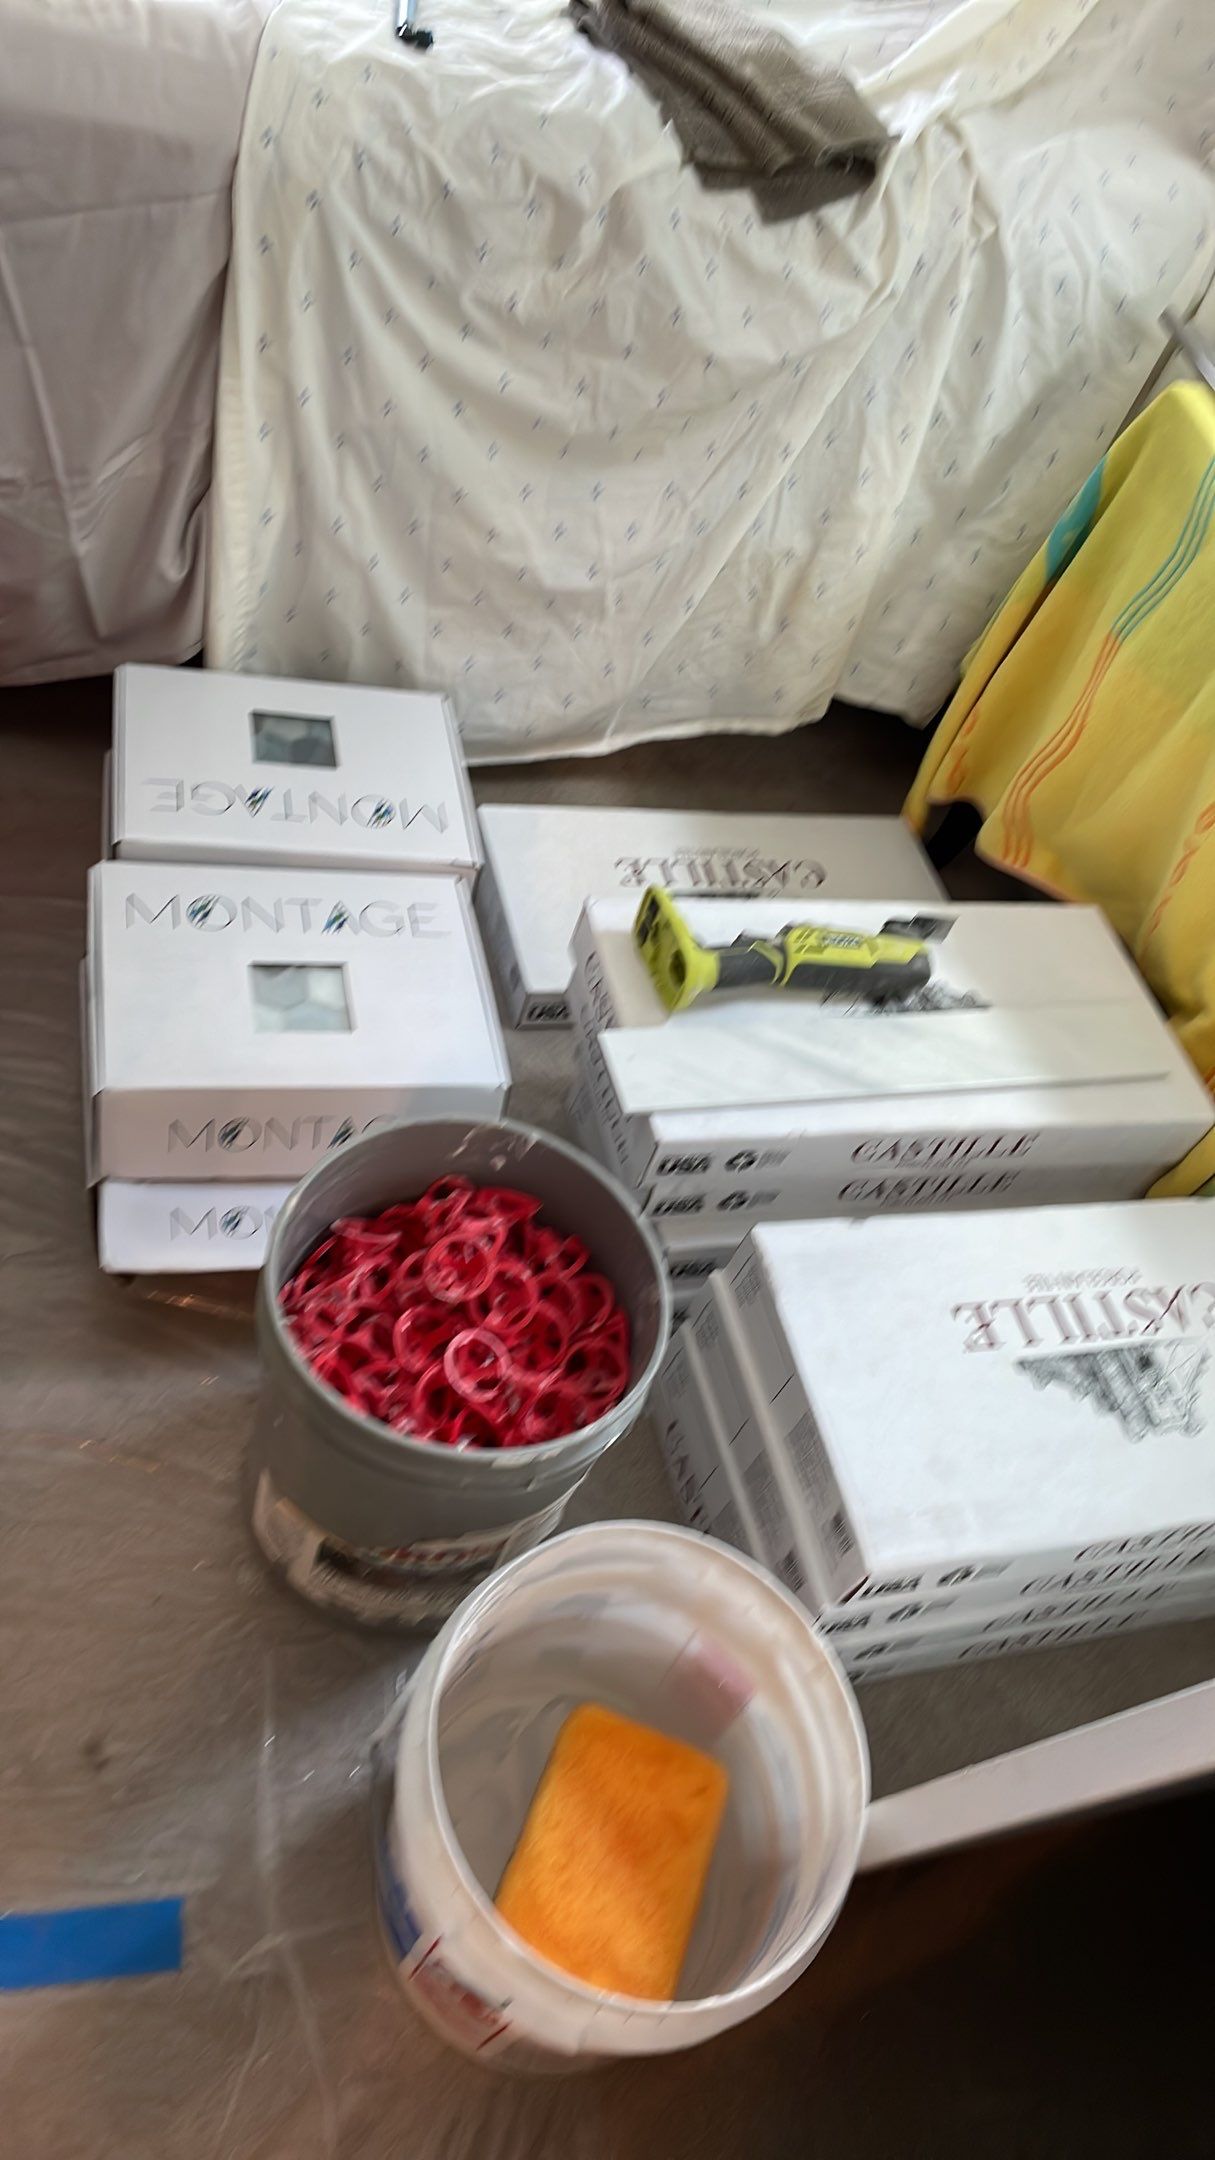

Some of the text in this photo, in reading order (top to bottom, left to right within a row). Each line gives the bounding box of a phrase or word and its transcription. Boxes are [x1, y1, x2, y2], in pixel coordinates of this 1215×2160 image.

[142, 778, 448, 833] MONTAGE
[125, 892, 452, 938] MONTAGE
[168, 1115, 398, 1152] MONTA
